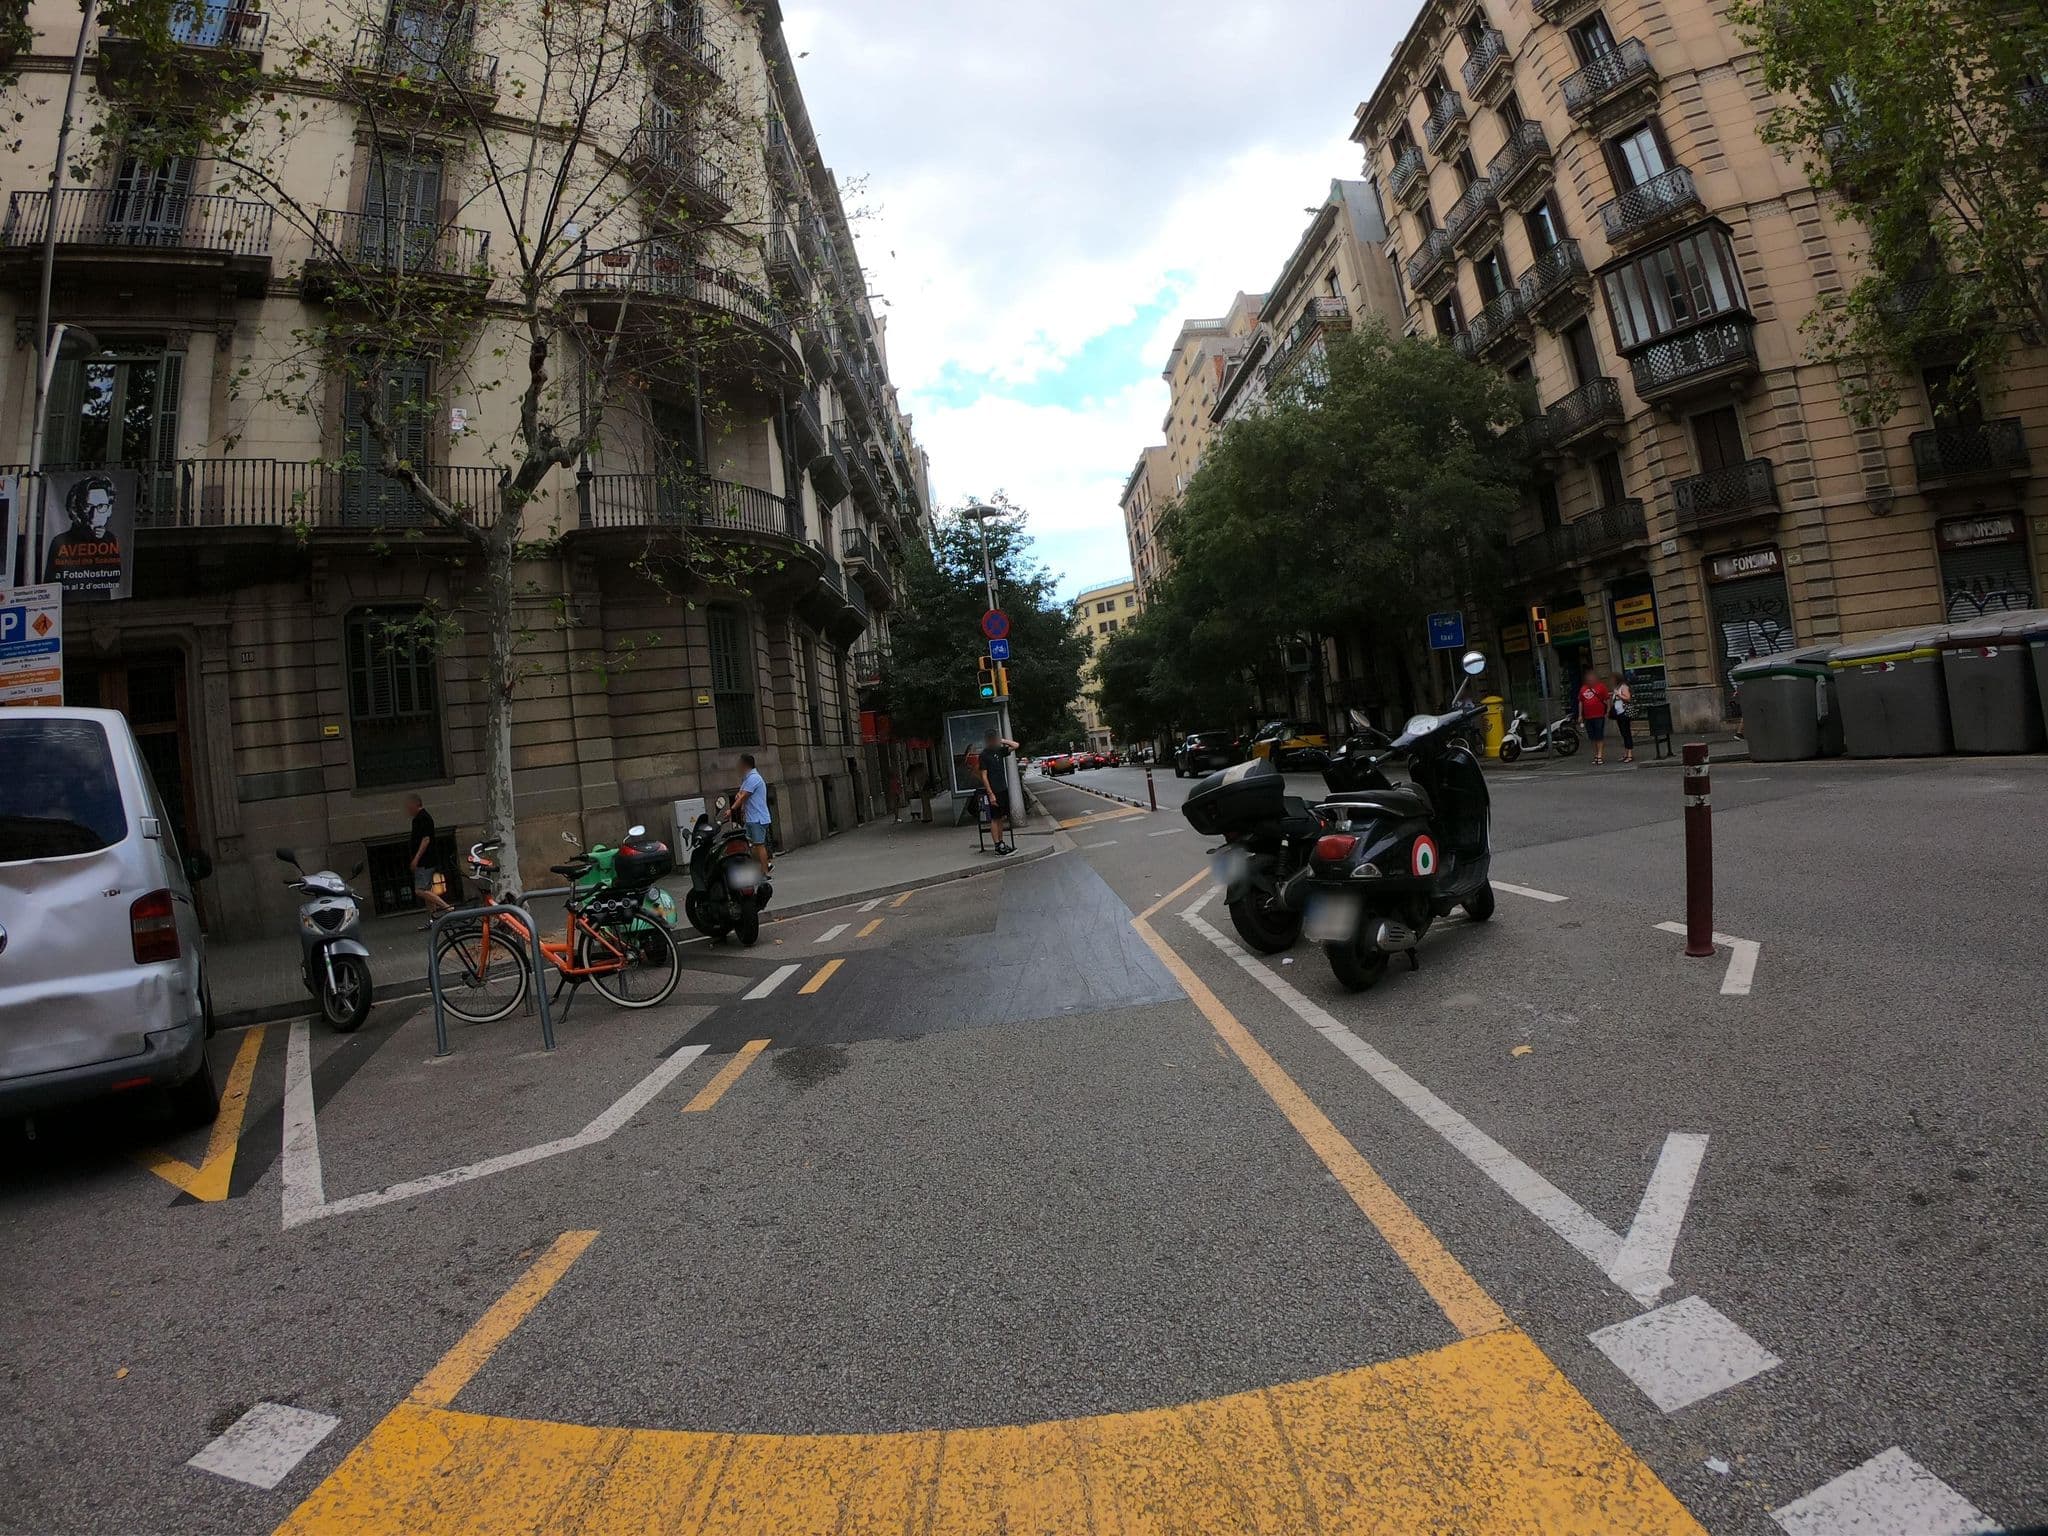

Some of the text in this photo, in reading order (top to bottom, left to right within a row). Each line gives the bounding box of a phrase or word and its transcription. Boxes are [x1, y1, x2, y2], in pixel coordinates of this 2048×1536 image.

[58, 542, 119, 557] AVEDON
[63, 569, 121, 579] FotoNostrum
[72, 583, 79, 591] al
[1, 612, 18, 641] P
